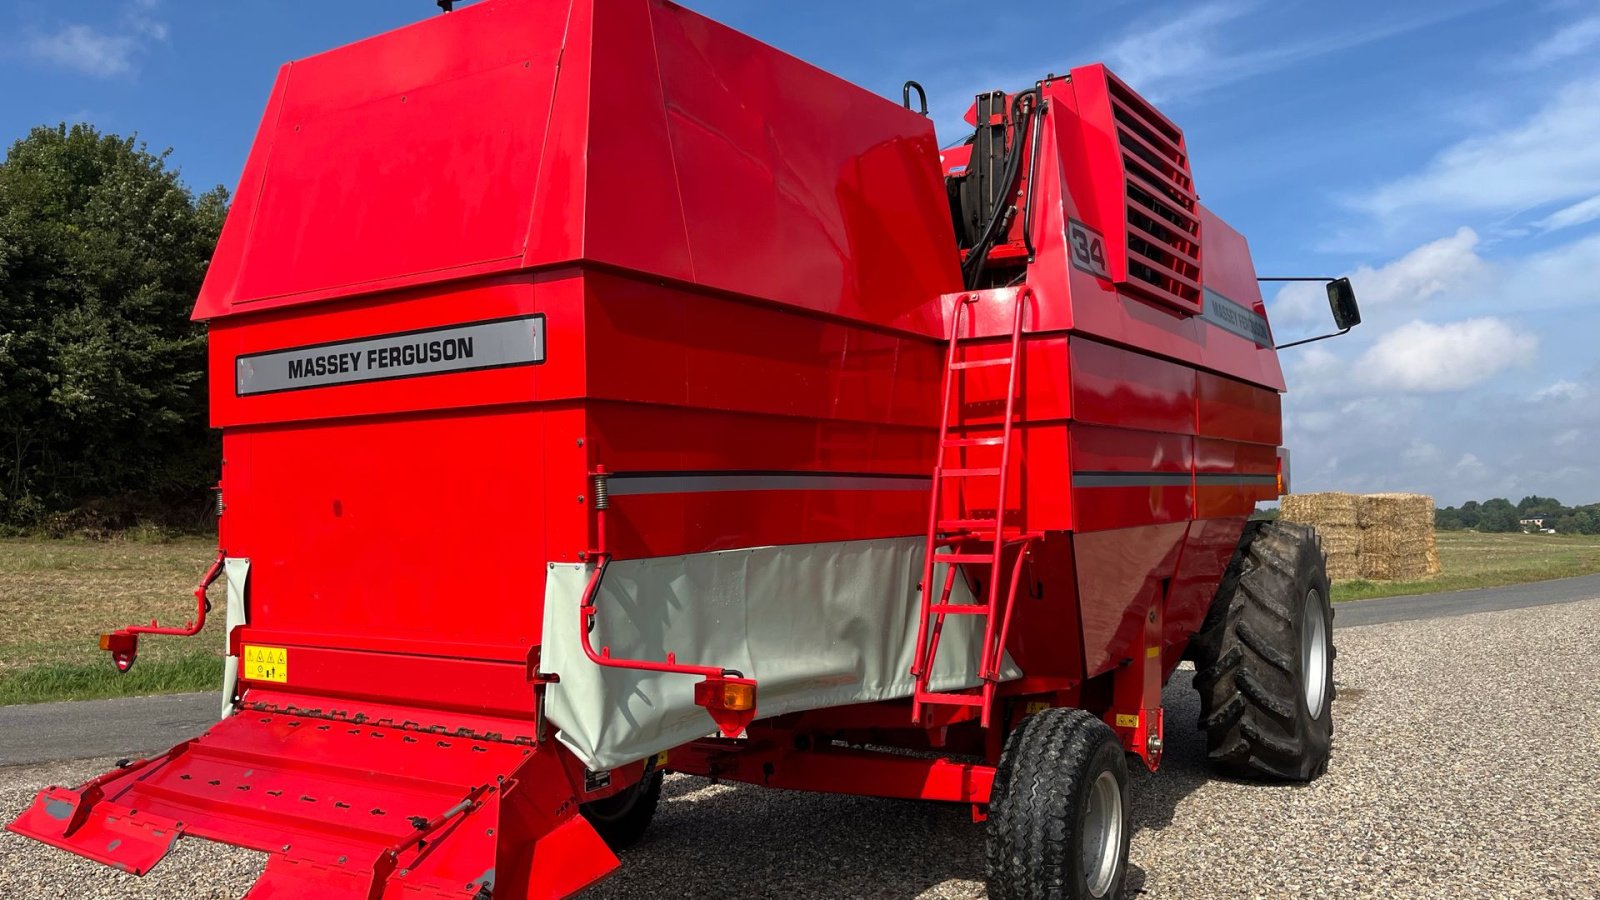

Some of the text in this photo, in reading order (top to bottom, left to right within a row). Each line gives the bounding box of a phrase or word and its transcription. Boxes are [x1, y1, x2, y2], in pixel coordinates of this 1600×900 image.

[1072, 225, 1106, 272] 34
[1211, 300, 1238, 327] MASSEY
[288, 336, 474, 380] MASSEY FERGUSON
